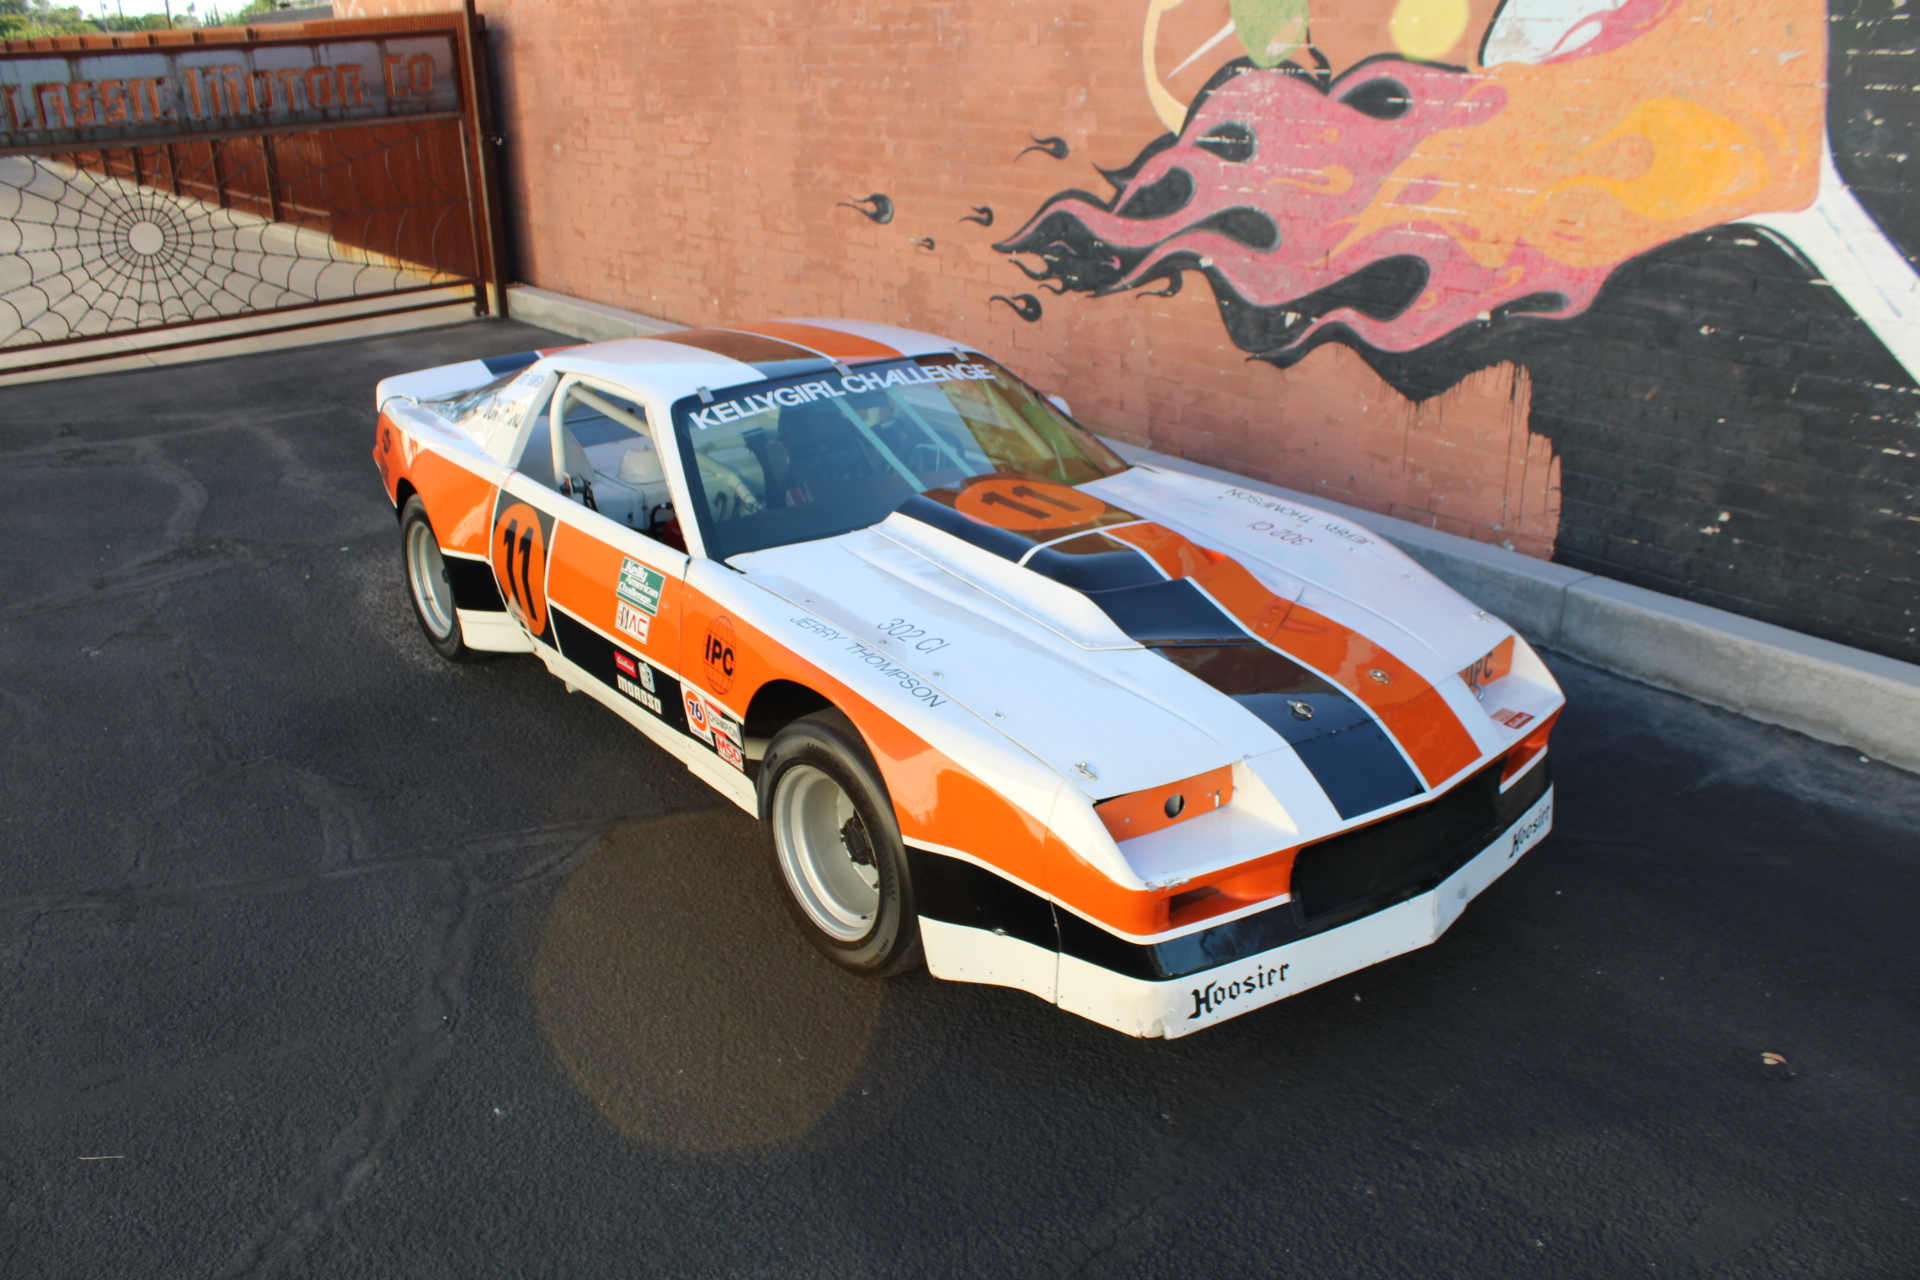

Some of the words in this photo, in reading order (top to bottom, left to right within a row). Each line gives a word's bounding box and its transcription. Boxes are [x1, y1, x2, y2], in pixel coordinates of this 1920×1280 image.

[0, 76, 176, 133] LASSIC
[182, 63, 373, 120] MOTOR
[841, 363, 996, 394] CHALLENGE
[981, 485, 1083, 519] 11
[1225, 488, 1314, 523] THOMPSON
[1270, 529, 1313, 545] 302
[1318, 523, 1374, 546] JERRY
[503, 518, 539, 623] 11
[624, 560, 648, 583] Kelly
[625, 574, 659, 599] American
[619, 580, 652, 604] Challenge
[877, 618, 926, 642] 302
[915, 637, 951, 654] CI
[704, 634, 735, 677] IPC
[790, 617, 848, 641] JERRY
[845, 642, 947, 708] THOMPSON
[616, 674, 662, 715] MOROSO
[689, 700, 703, 721] 76
[708, 711, 739, 740] CHAMPION
[716, 736, 743, 763] MSD
[1508, 804, 1550, 858] Hoosier
[1187, 963, 1290, 1020] Hoosier
